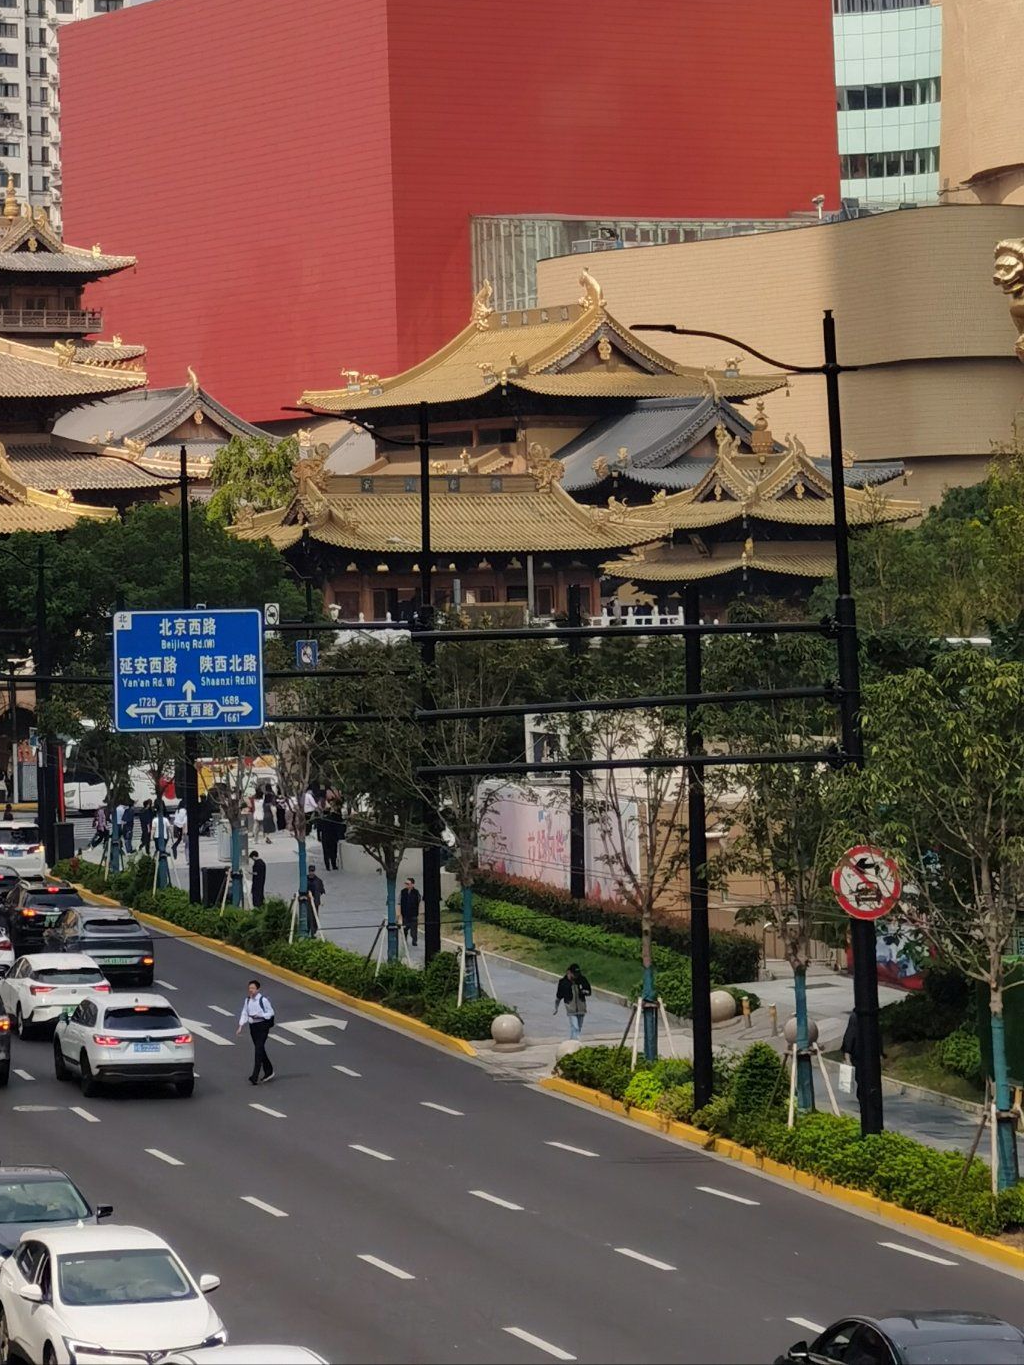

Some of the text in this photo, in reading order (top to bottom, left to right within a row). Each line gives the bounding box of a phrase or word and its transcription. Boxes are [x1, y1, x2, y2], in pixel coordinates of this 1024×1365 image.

[159, 618, 216, 636] 北京西路
[161, 639, 190, 652] Beijing
[119, 656, 177, 674] 延安西路
[199, 654, 257, 673] 陕西北路
[122, 677, 150, 687] Yan'an
[201, 676, 233, 686] Shaanxi
[165, 703, 214, 717] 南京西路
[140, 714, 156, 725] 1717
[224, 713, 240, 723] 1661
